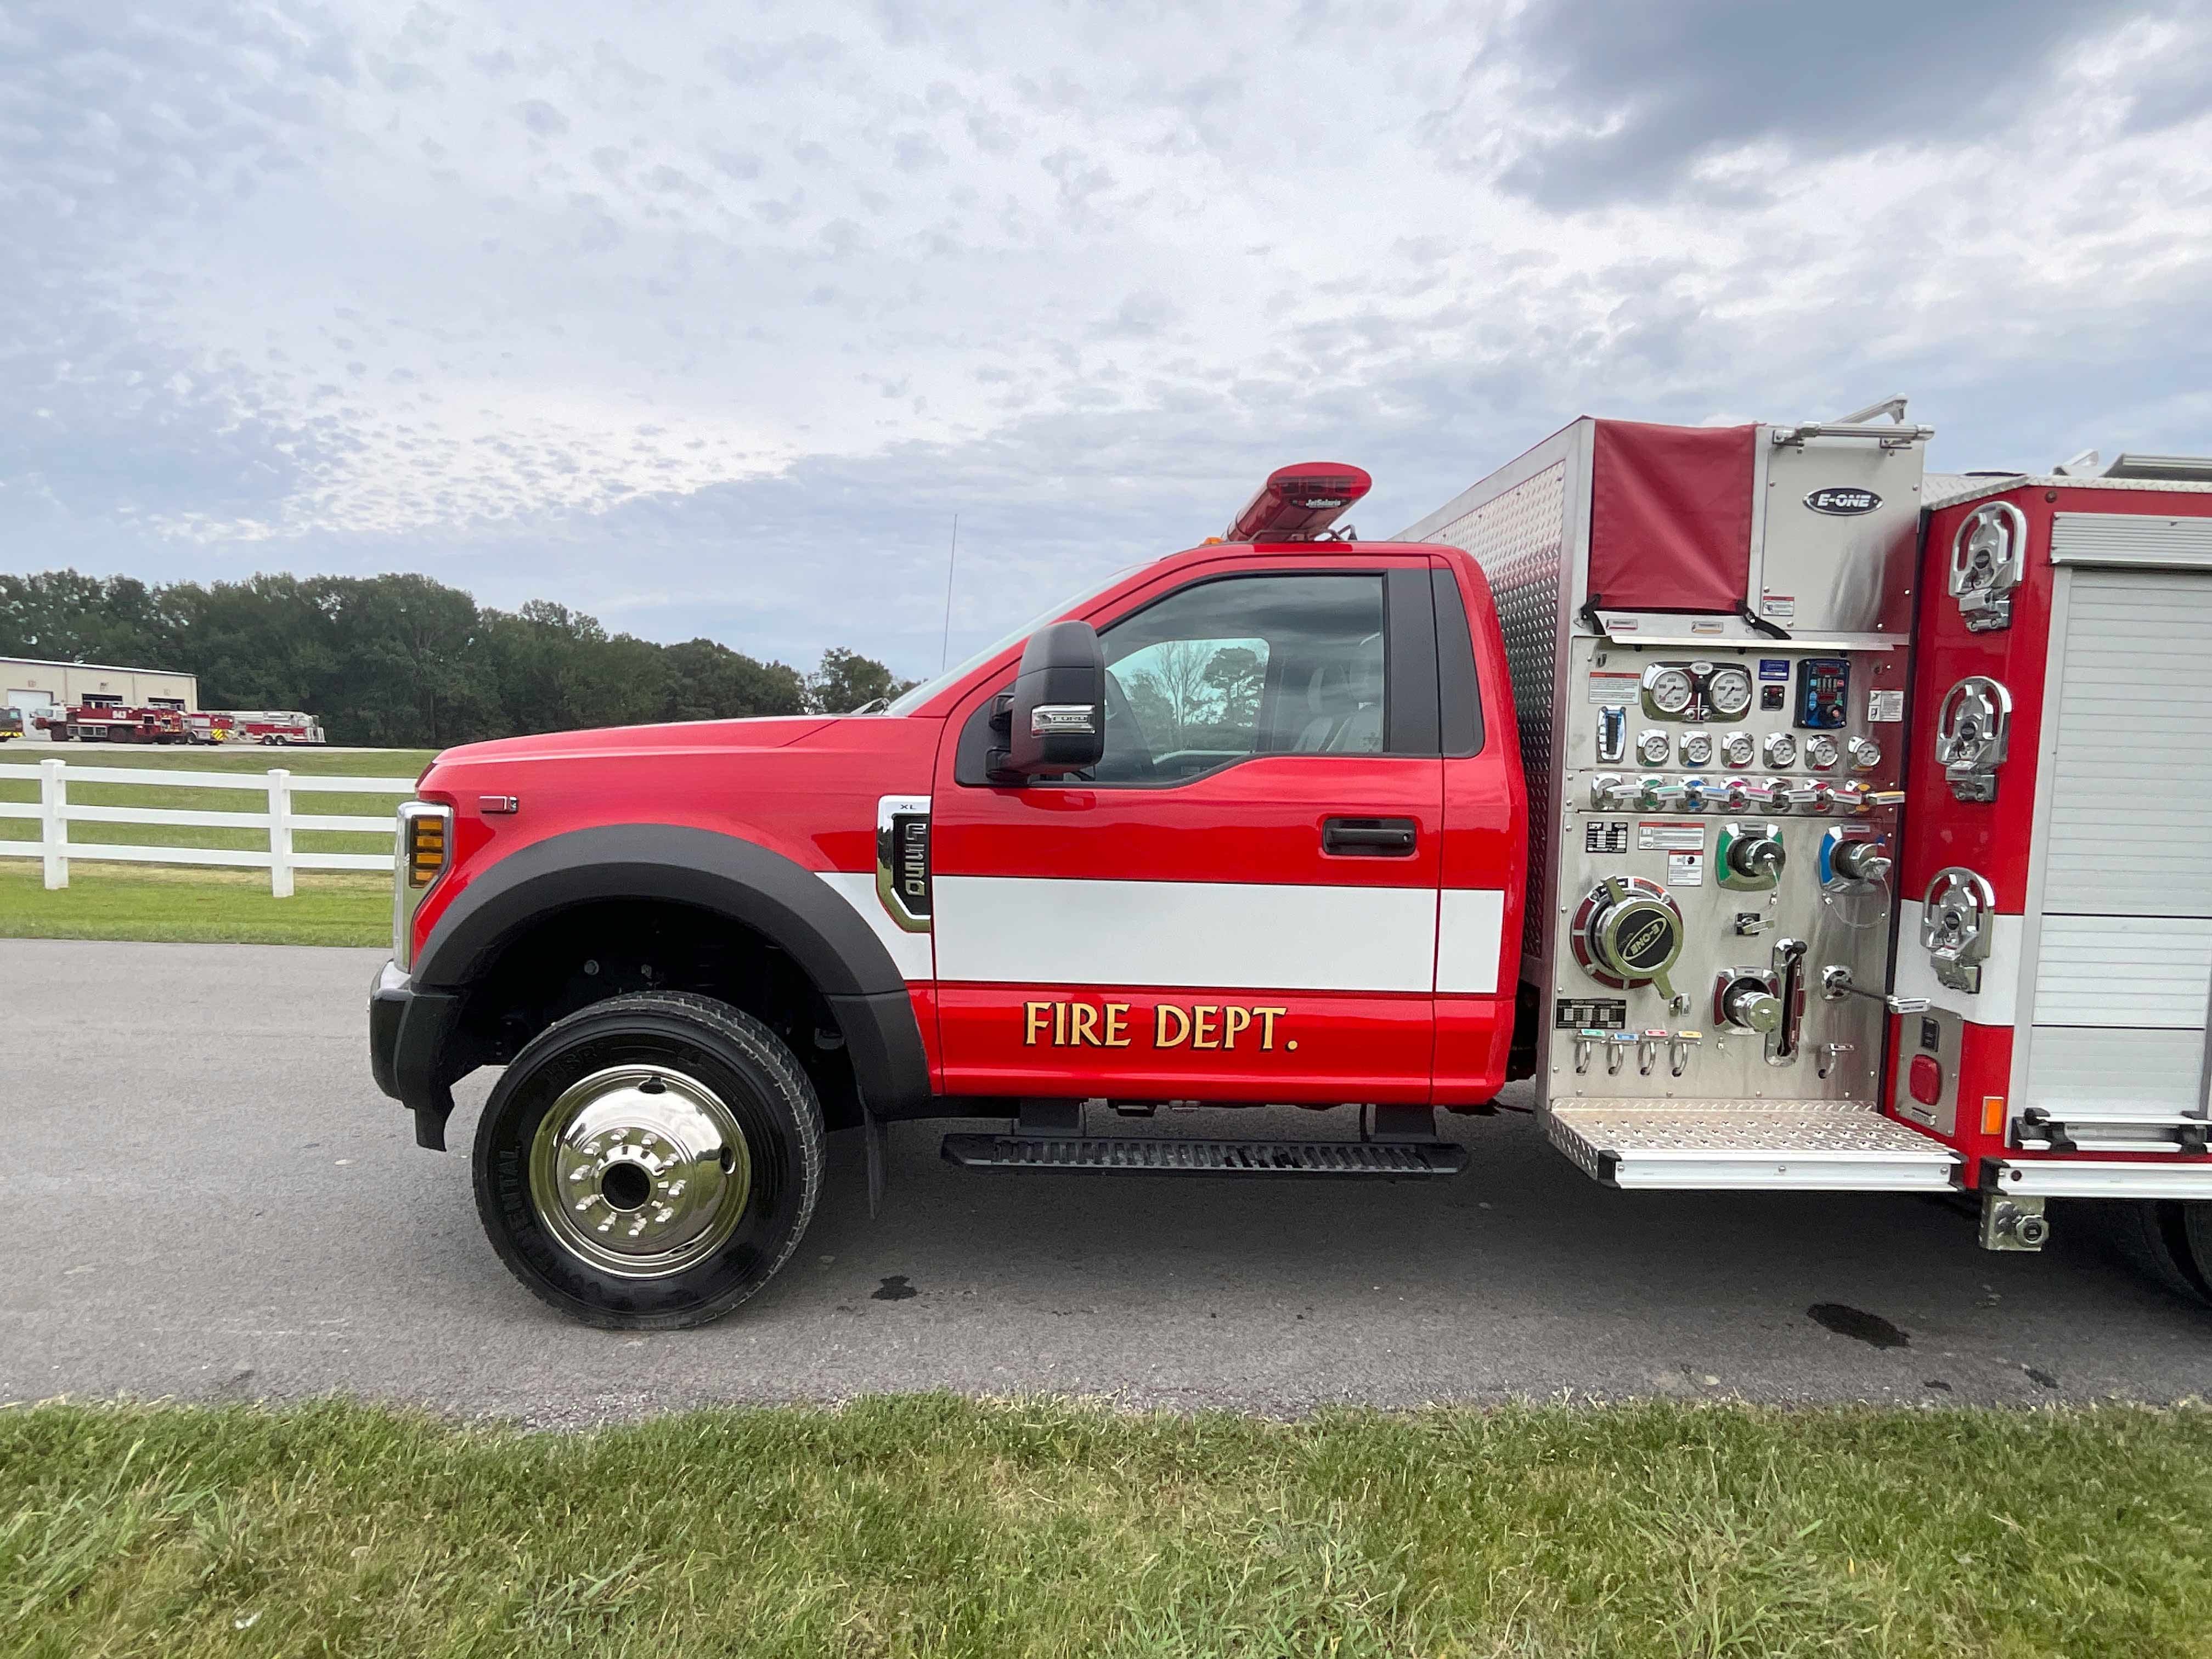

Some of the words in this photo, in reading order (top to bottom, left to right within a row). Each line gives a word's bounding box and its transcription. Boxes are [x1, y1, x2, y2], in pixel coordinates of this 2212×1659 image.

[1817, 493, 1871, 507] E-ONE
[1630, 923, 1660, 956] E-ONE
[1024, 1002, 1132, 1047] FIRE
[1154, 1004, 1298, 1053] DEPT.
